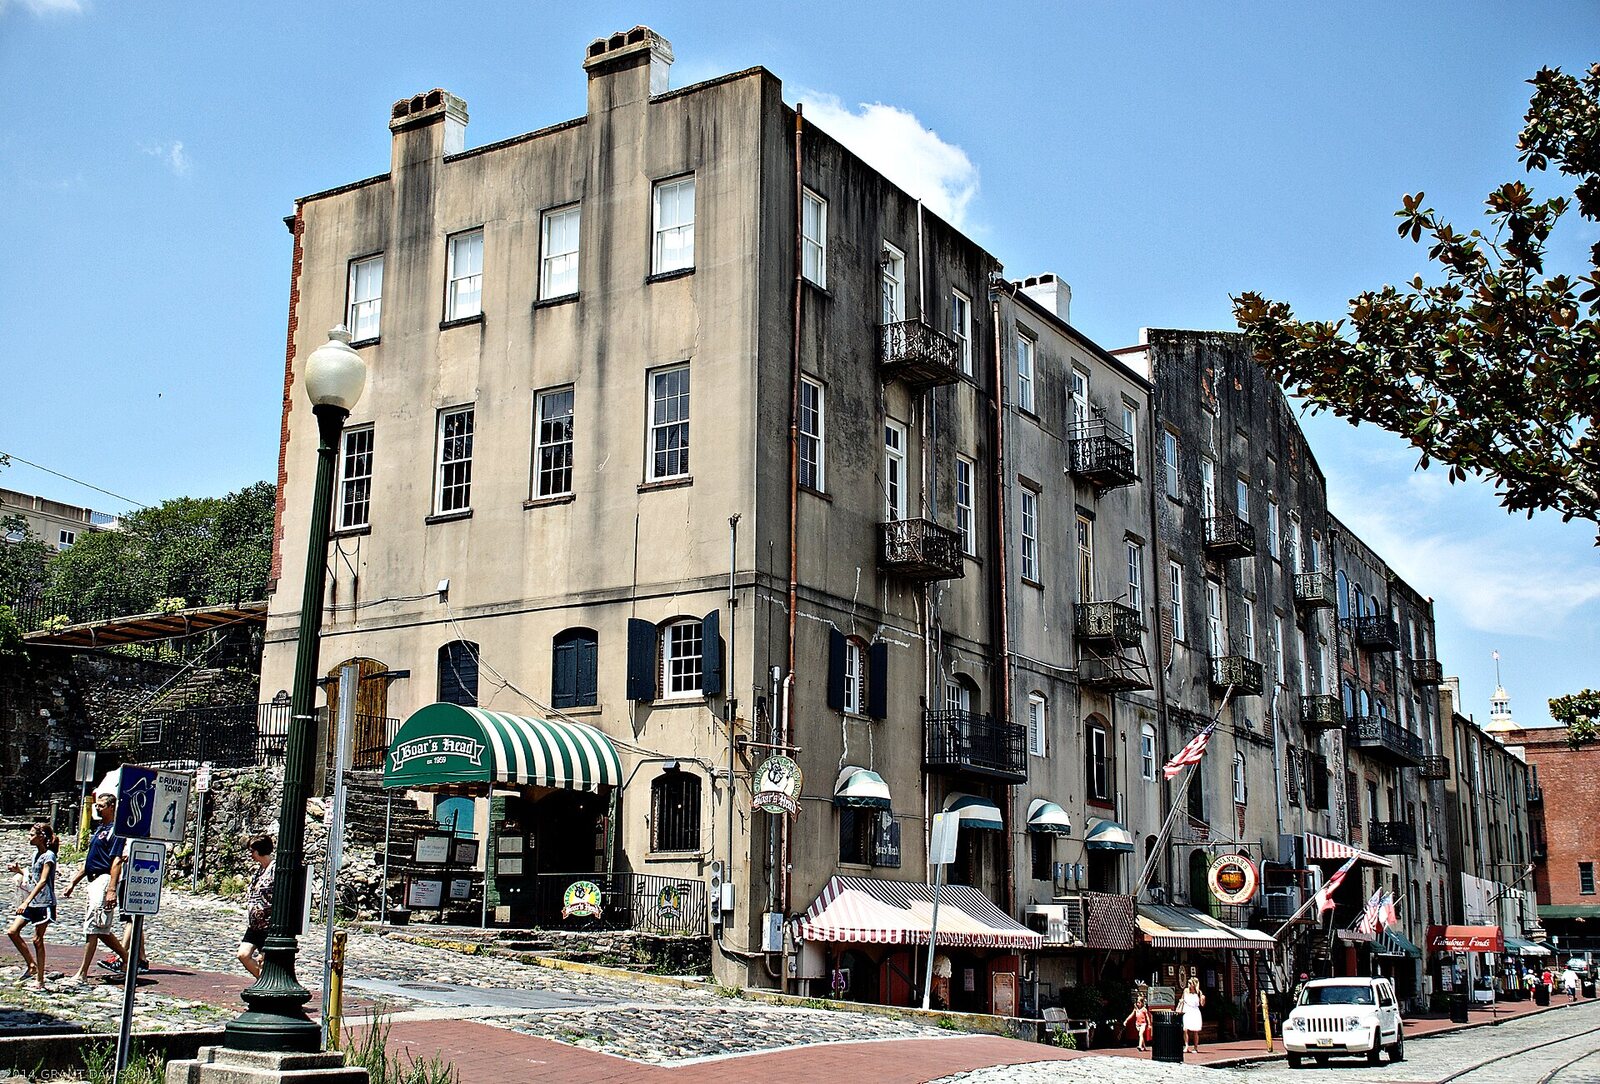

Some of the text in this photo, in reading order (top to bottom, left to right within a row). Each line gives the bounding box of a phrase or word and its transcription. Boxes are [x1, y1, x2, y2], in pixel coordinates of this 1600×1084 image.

[401, 738, 474, 758] Boar's Head
[434, 756, 447, 764] 1959
[159, 776, 188, 787] DRIVING
[164, 784, 182, 793] TOUR
[753, 792, 797, 814] Boar's Head
[162, 800, 177, 833] 4
[131, 875, 159, 885] BUS STOP
[922, 930, 1031, 947] SAANNAH'S CANDY KITCHEN
[1433, 936, 1465, 946] Fabulous
[1469, 936, 1490, 947] Finds
